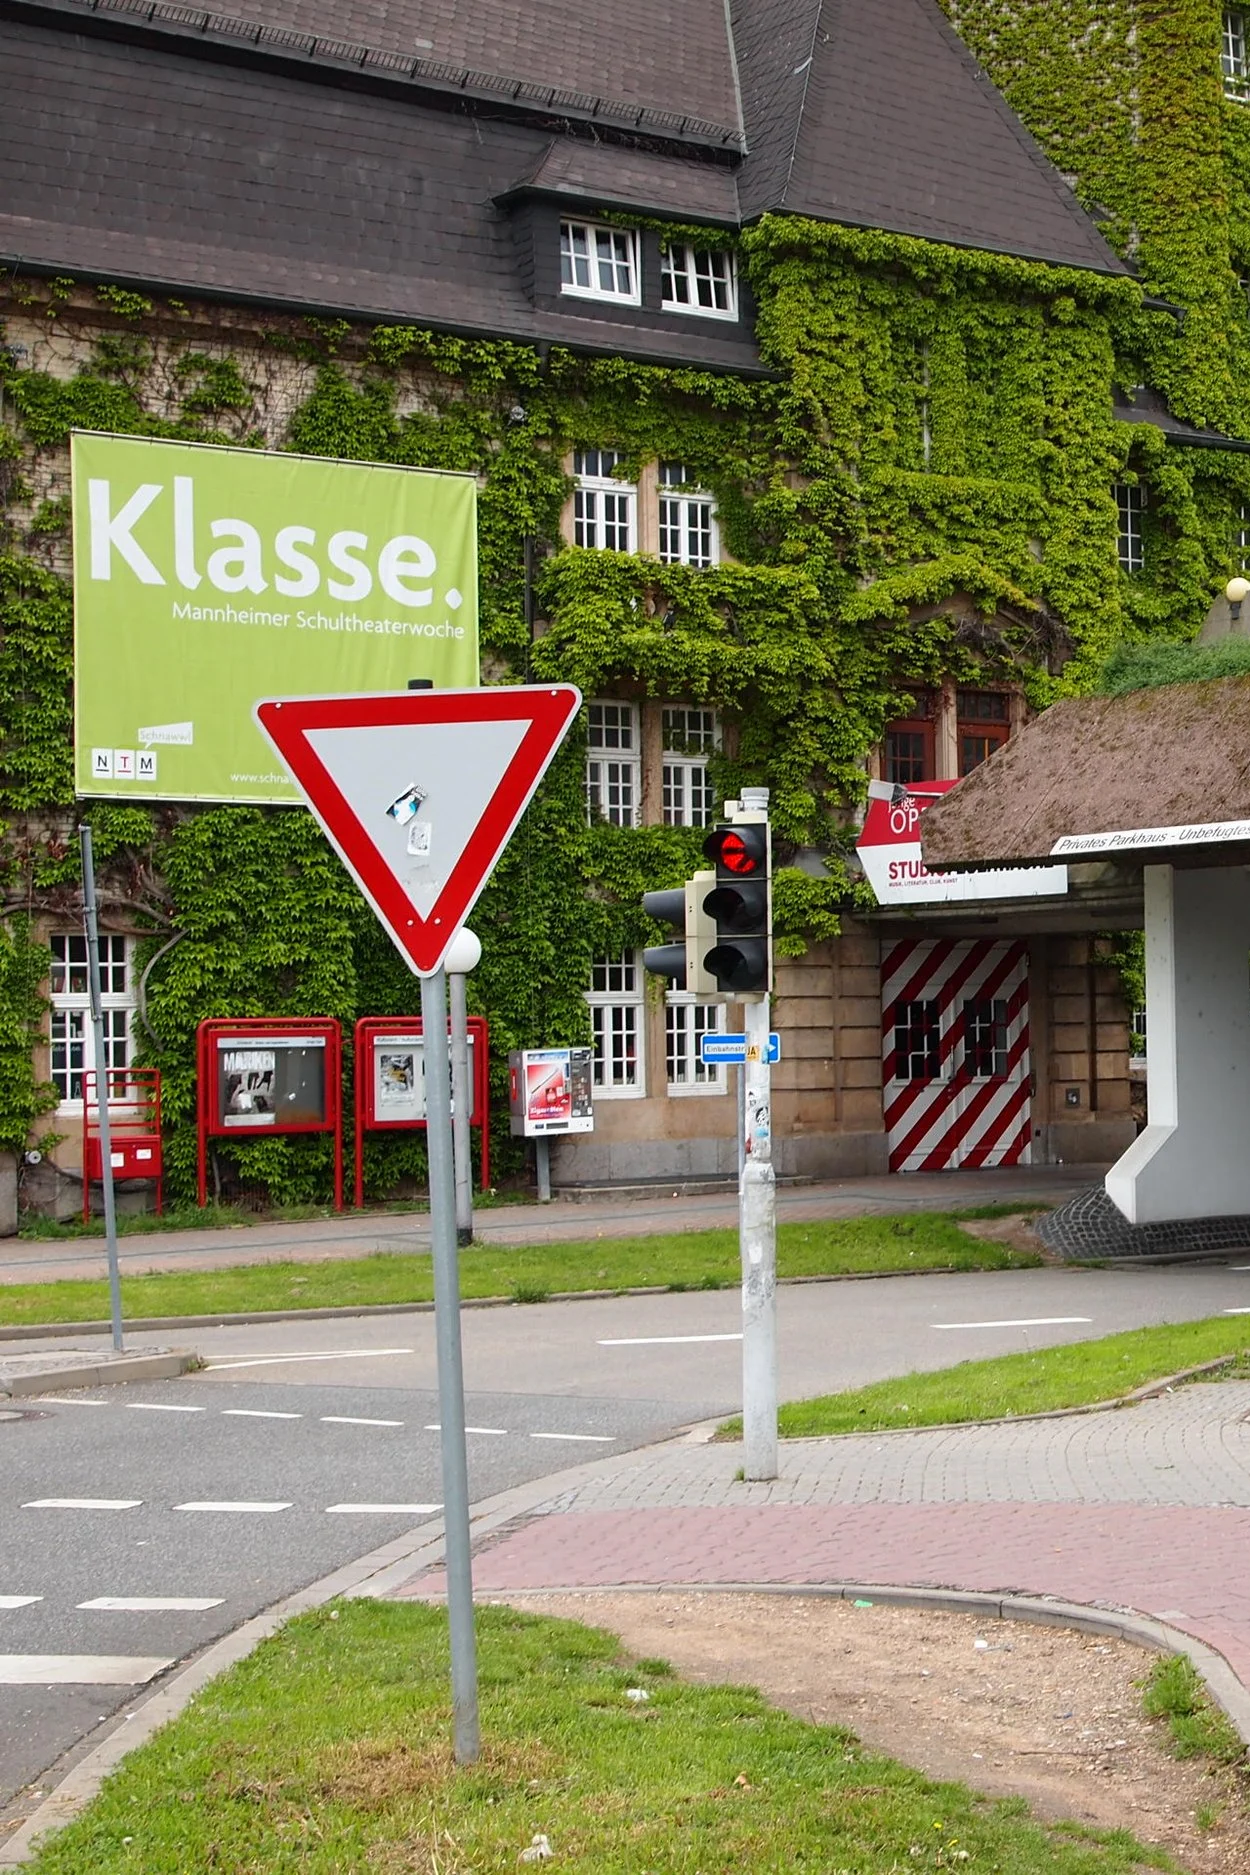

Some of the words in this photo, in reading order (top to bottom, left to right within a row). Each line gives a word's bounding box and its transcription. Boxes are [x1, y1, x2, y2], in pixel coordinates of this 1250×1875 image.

[88, 476, 463, 610] Klasse.
[172, 602, 290, 627] Mannheimer
[296, 611, 465, 639] Schultheaterwoche
[230, 772, 290, 784] www.schna
[888, 797, 916, 813] Jge
[890, 806, 927, 834] OP
[1059, 838, 1107, 850] Privates
[1109, 832, 1167, 846] Parkhaus
[706, 1045, 746, 1053] Einbahnstr
